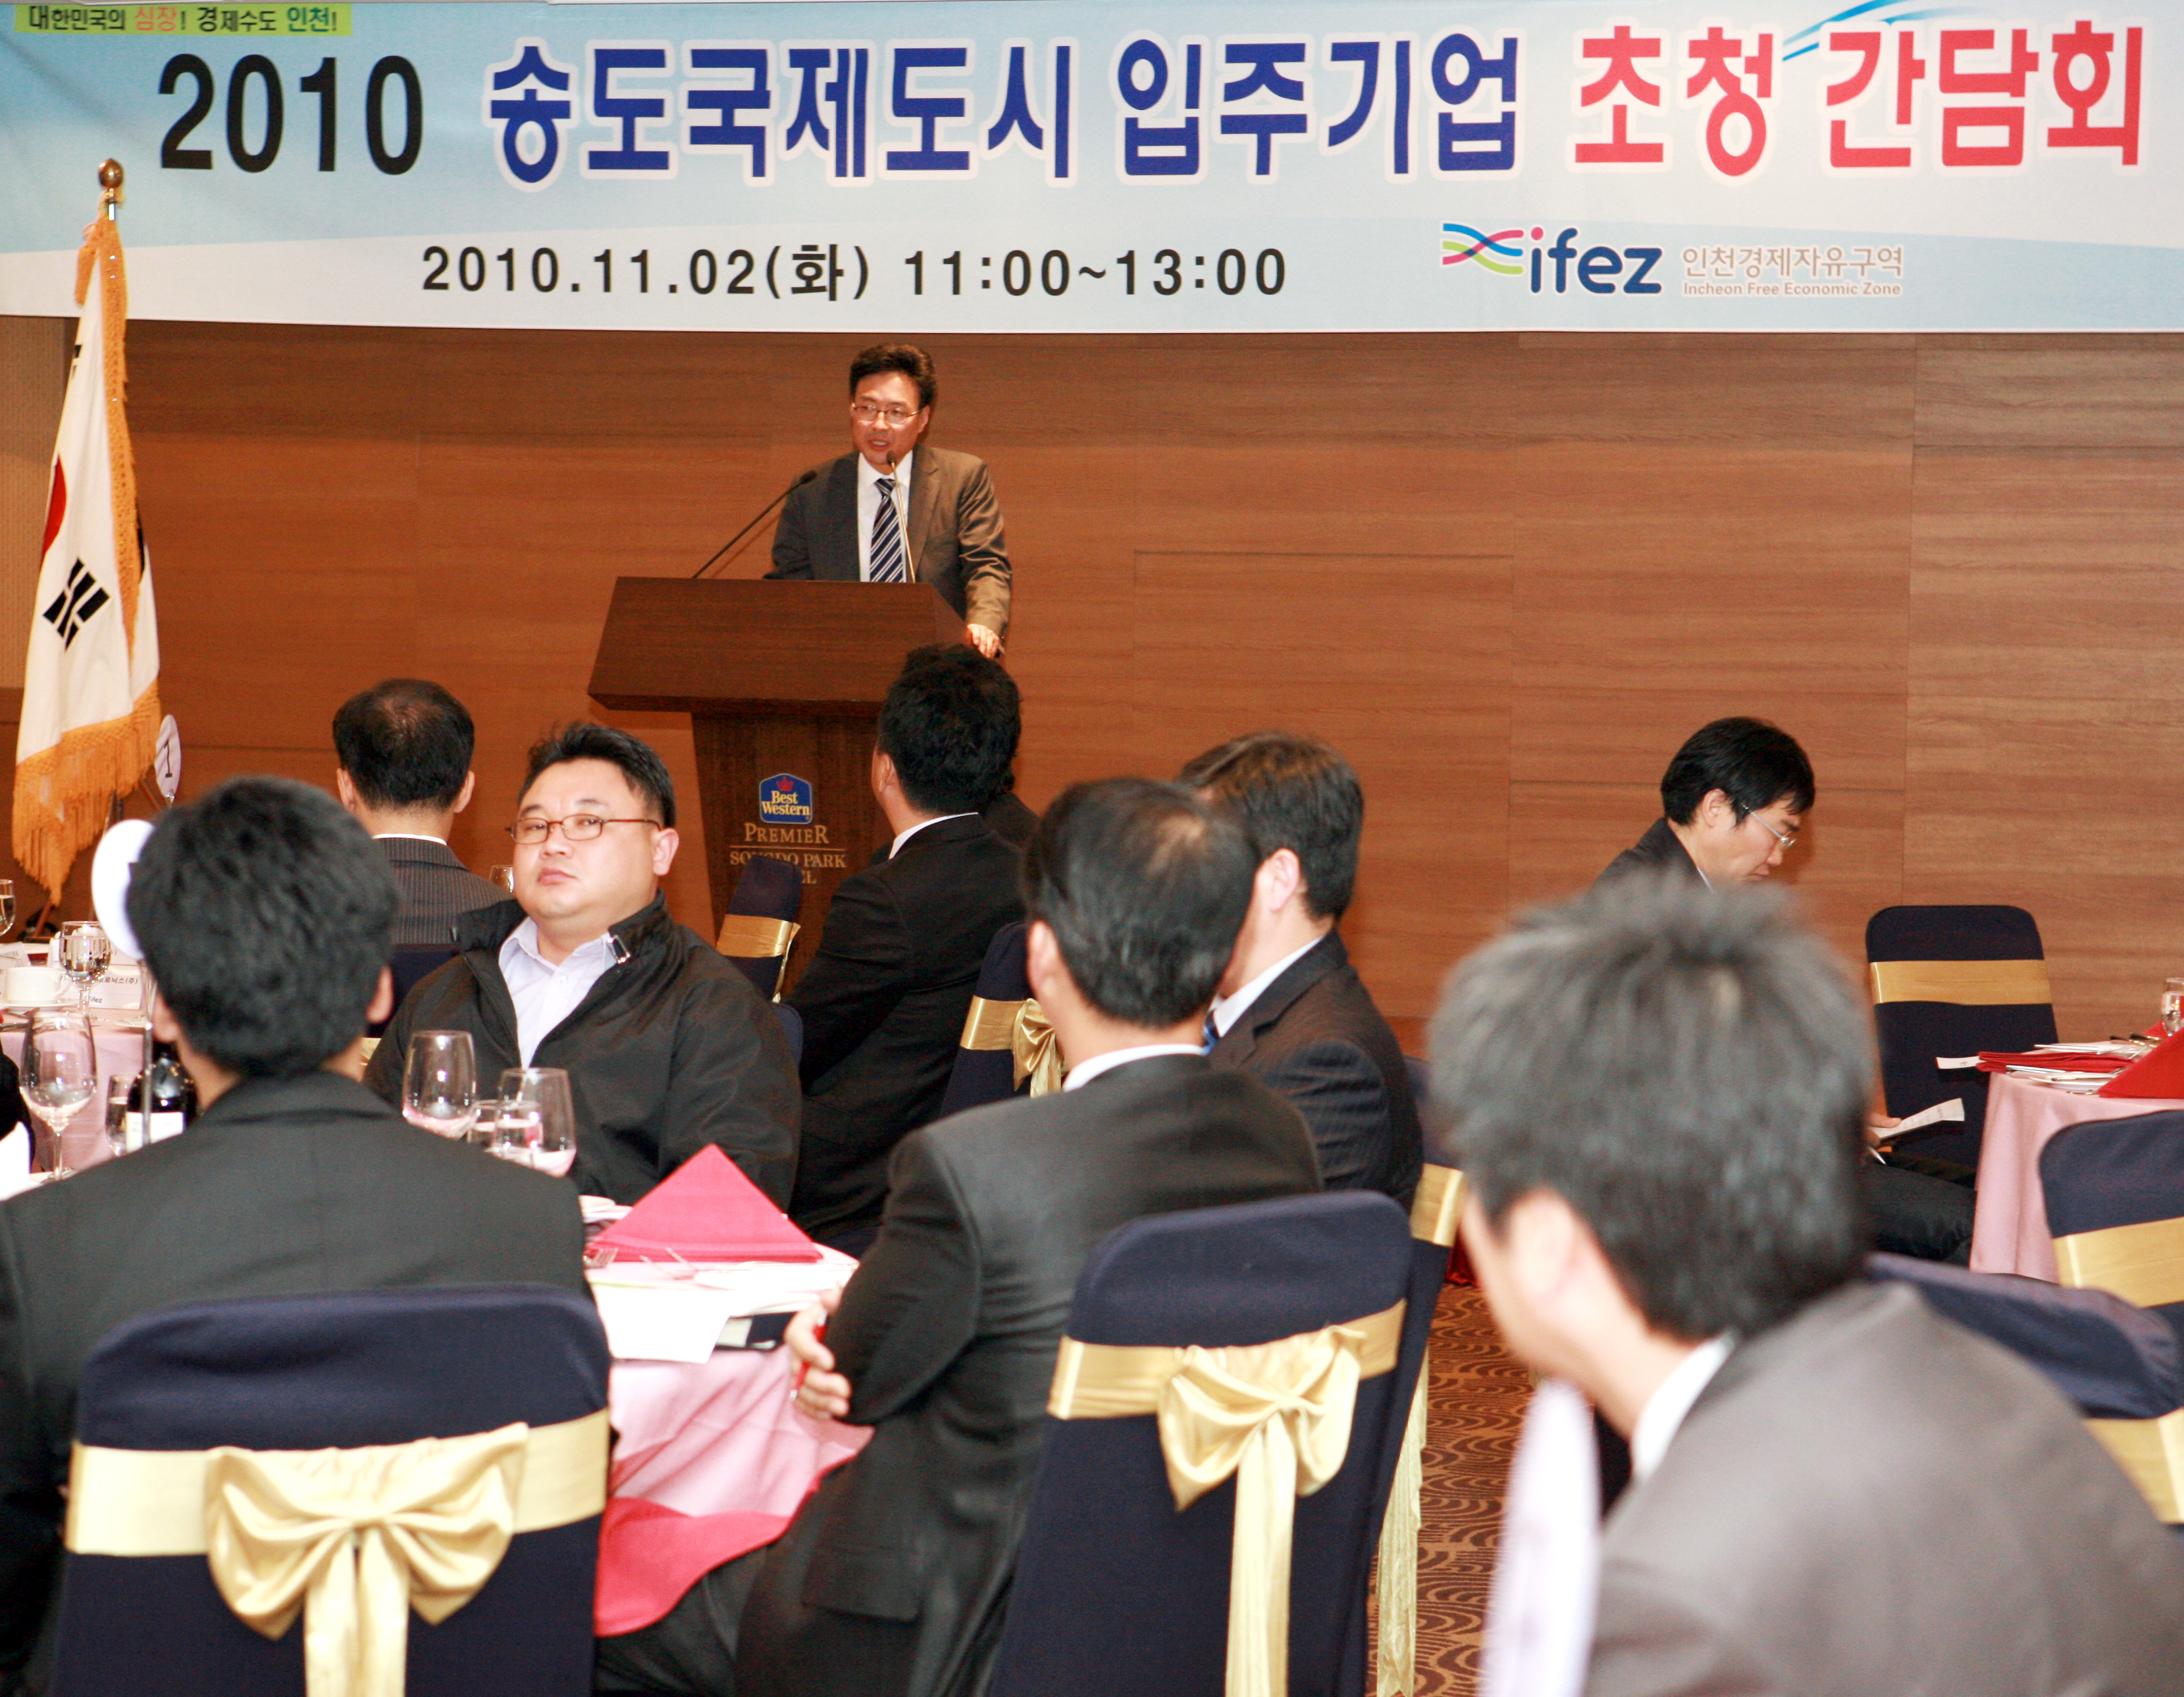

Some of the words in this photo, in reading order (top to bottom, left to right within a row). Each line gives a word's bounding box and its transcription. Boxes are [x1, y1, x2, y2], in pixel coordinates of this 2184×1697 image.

[29, 5, 126, 31] 대한민국의
[134, 6, 186, 31] 심장!
[197, 7, 276, 32] 경제수도
[287, 6, 337, 32] 인천!
[158, 53, 423, 175] 2010
[490, 45, 1072, 183] 송도국제도시
[1117, 33, 1518, 176] 입주기업
[1574, 25, 1774, 177] 초청
[1826, 20, 2143, 168] 간담회
[1530, 226, 1663, 294] ifez
[1682, 246, 1903, 278] 인천경제자유구역
[422, 244, 870, 301] 2010.11.02(화)
[904, 248, 1286, 296] 11:00~13:00
[1684, 282, 1742, 296] Incheon
[1748, 282, 1779, 296] Free
[1784, 282, 1858, 296] Economic
[1863, 282, 1901, 296] Zone
[761, 801, 810, 816] Western
[771, 791, 798, 804] Best
[744, 823, 829, 844] PREMIER
[804, 854, 847, 868] PARK
